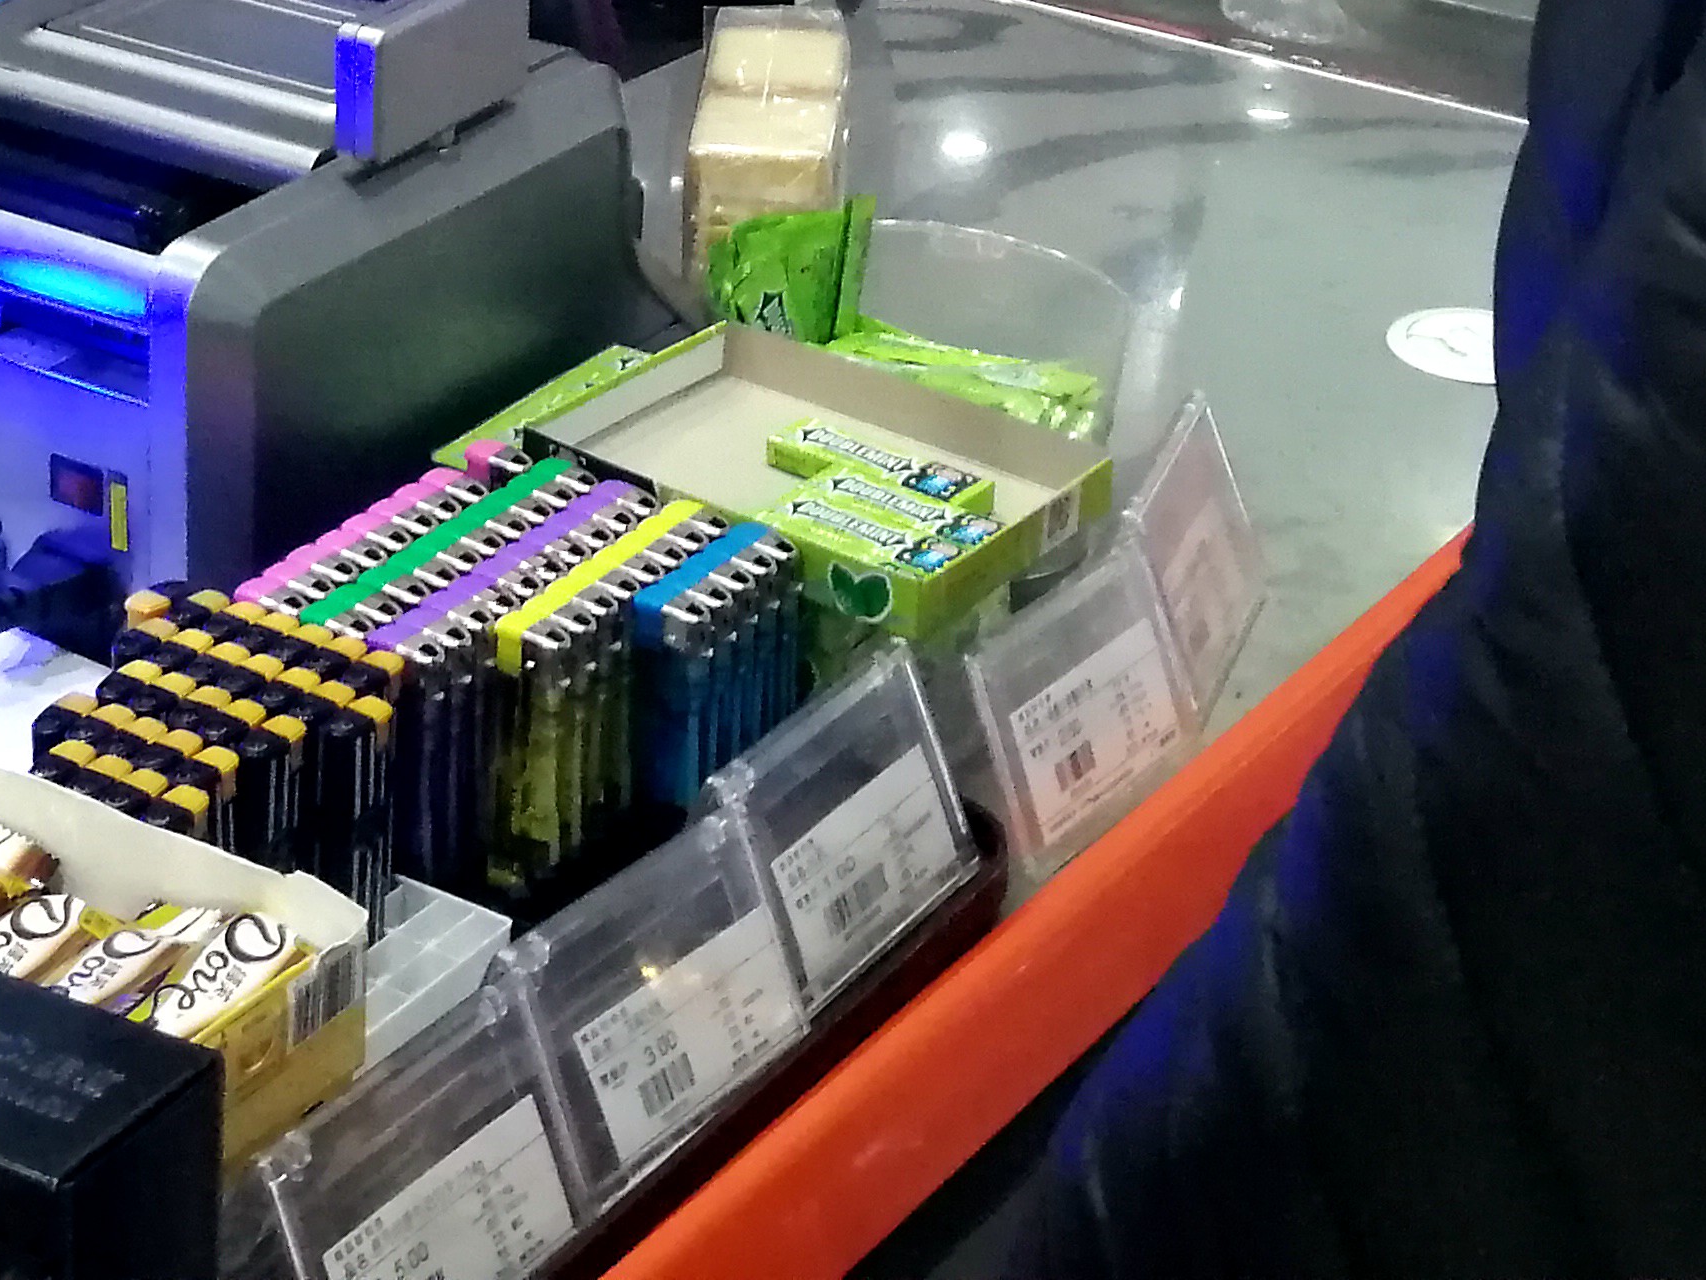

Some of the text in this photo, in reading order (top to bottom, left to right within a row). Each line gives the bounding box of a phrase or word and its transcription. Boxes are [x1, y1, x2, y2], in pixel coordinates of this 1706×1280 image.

[806, 426, 914, 474] DOUBLEMINT
[839, 475, 945, 522] DOUBLEMINT
[796, 500, 905, 547] DOUBLEMINT
[151, 913, 287, 1019] Dove
